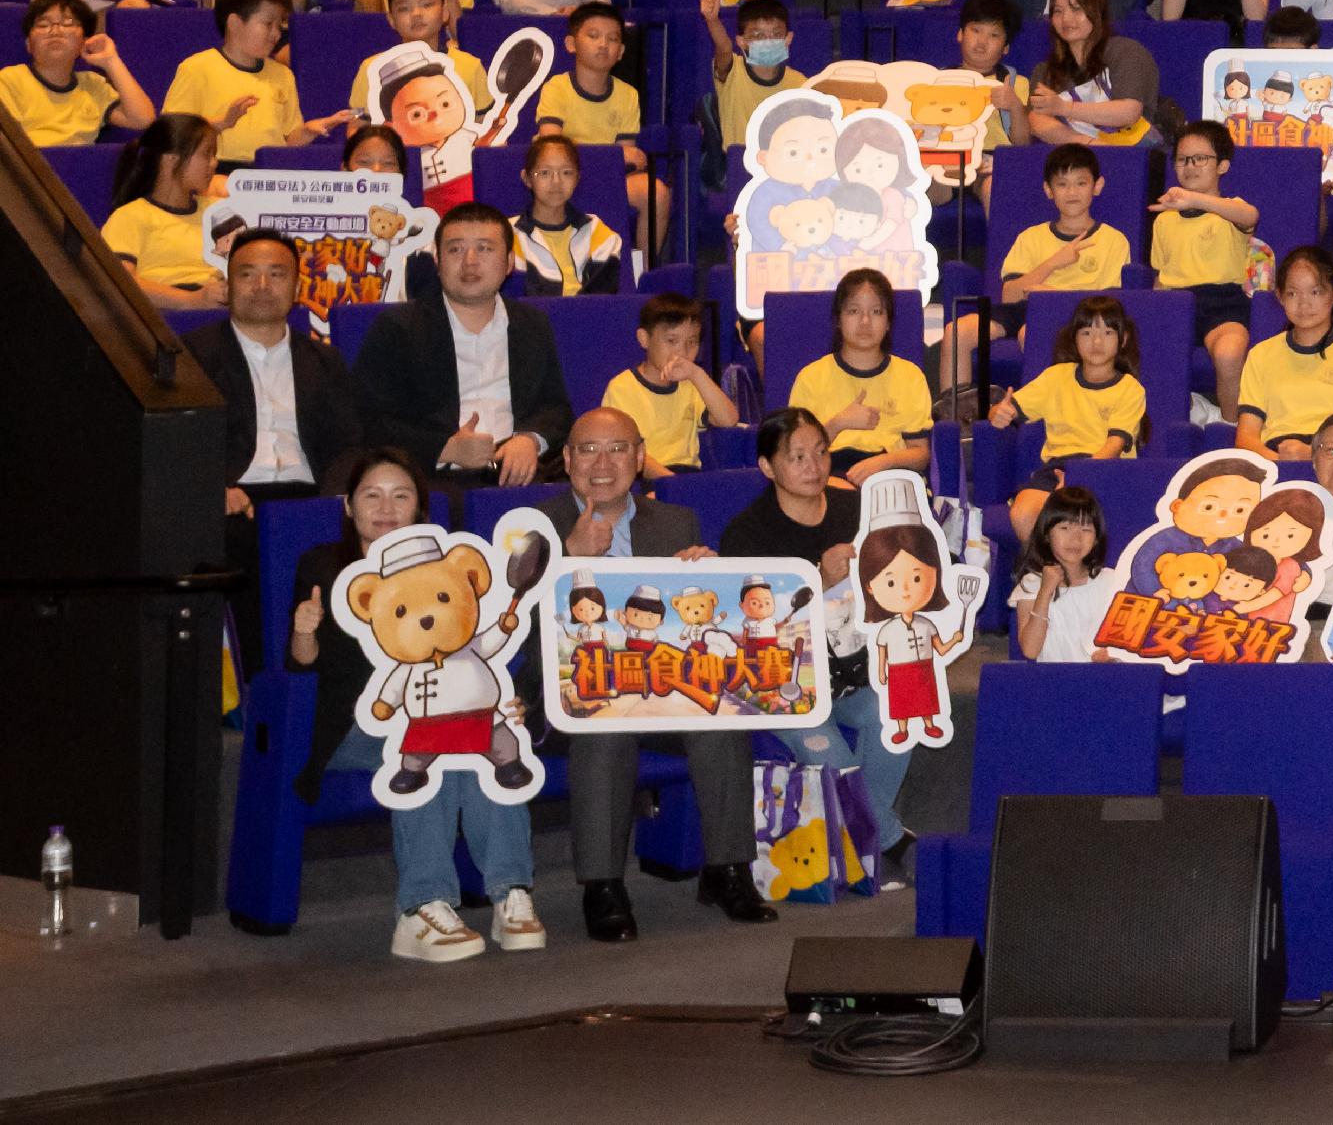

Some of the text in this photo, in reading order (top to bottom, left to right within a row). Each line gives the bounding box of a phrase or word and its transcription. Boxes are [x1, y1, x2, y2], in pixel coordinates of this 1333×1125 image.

[295, 234, 373, 274] 安家好
[1094, 591, 1297, 663] 國安家好
[576, 643, 793, 715] 社區食神大賽
